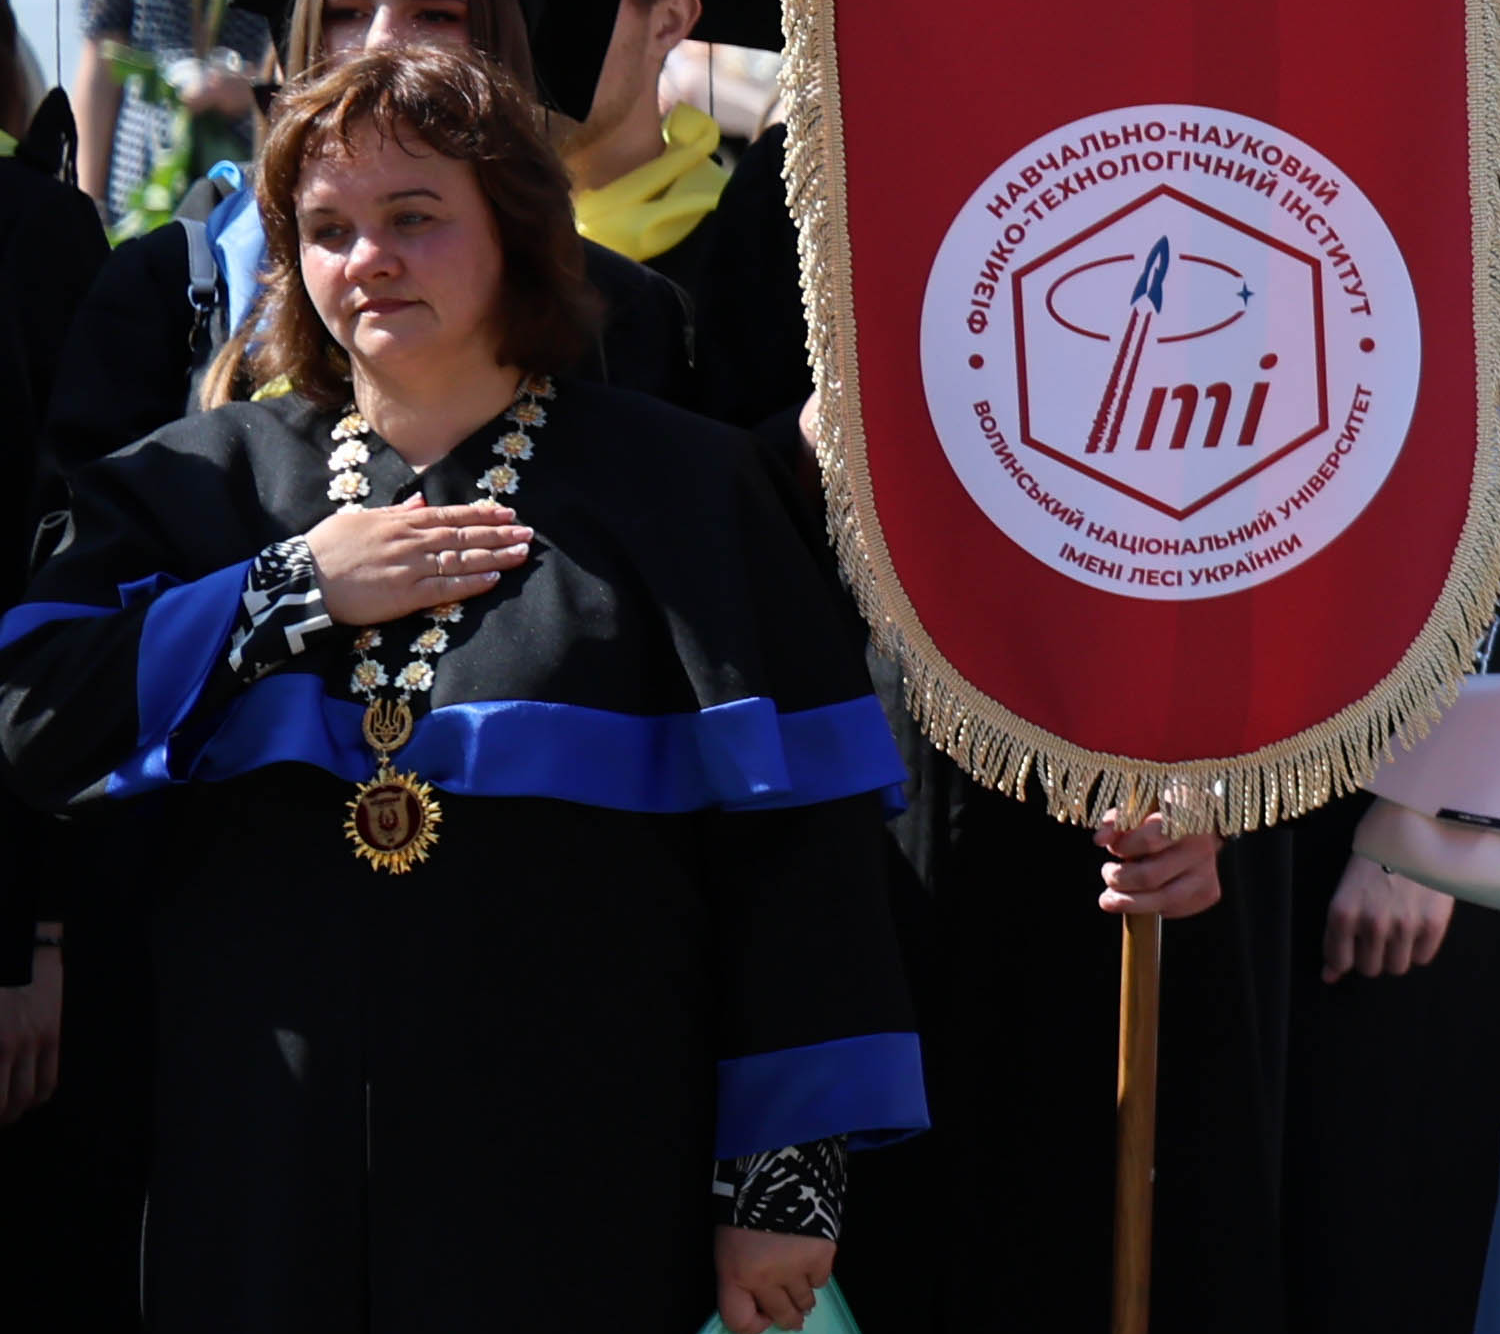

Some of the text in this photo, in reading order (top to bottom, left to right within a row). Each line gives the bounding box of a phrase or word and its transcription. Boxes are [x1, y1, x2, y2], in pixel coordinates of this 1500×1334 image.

[985, 121, 1341, 220] НАВЧАЛЬНО-НАУКОВИЙ
[966, 150, 1372, 335] ФІЗИКО-ТЕХНОЛОГІЧНИЙ ІНСТИТУТ
[972, 384, 1373, 556] ВОЛИНСЬКИЙ НАЦІОНАЛЬНИЙ УНІВЕРСИТЕТ
[1058, 533, 1304, 587] ІМЕНІ ЛЕСІ УКРАЇНКИ
